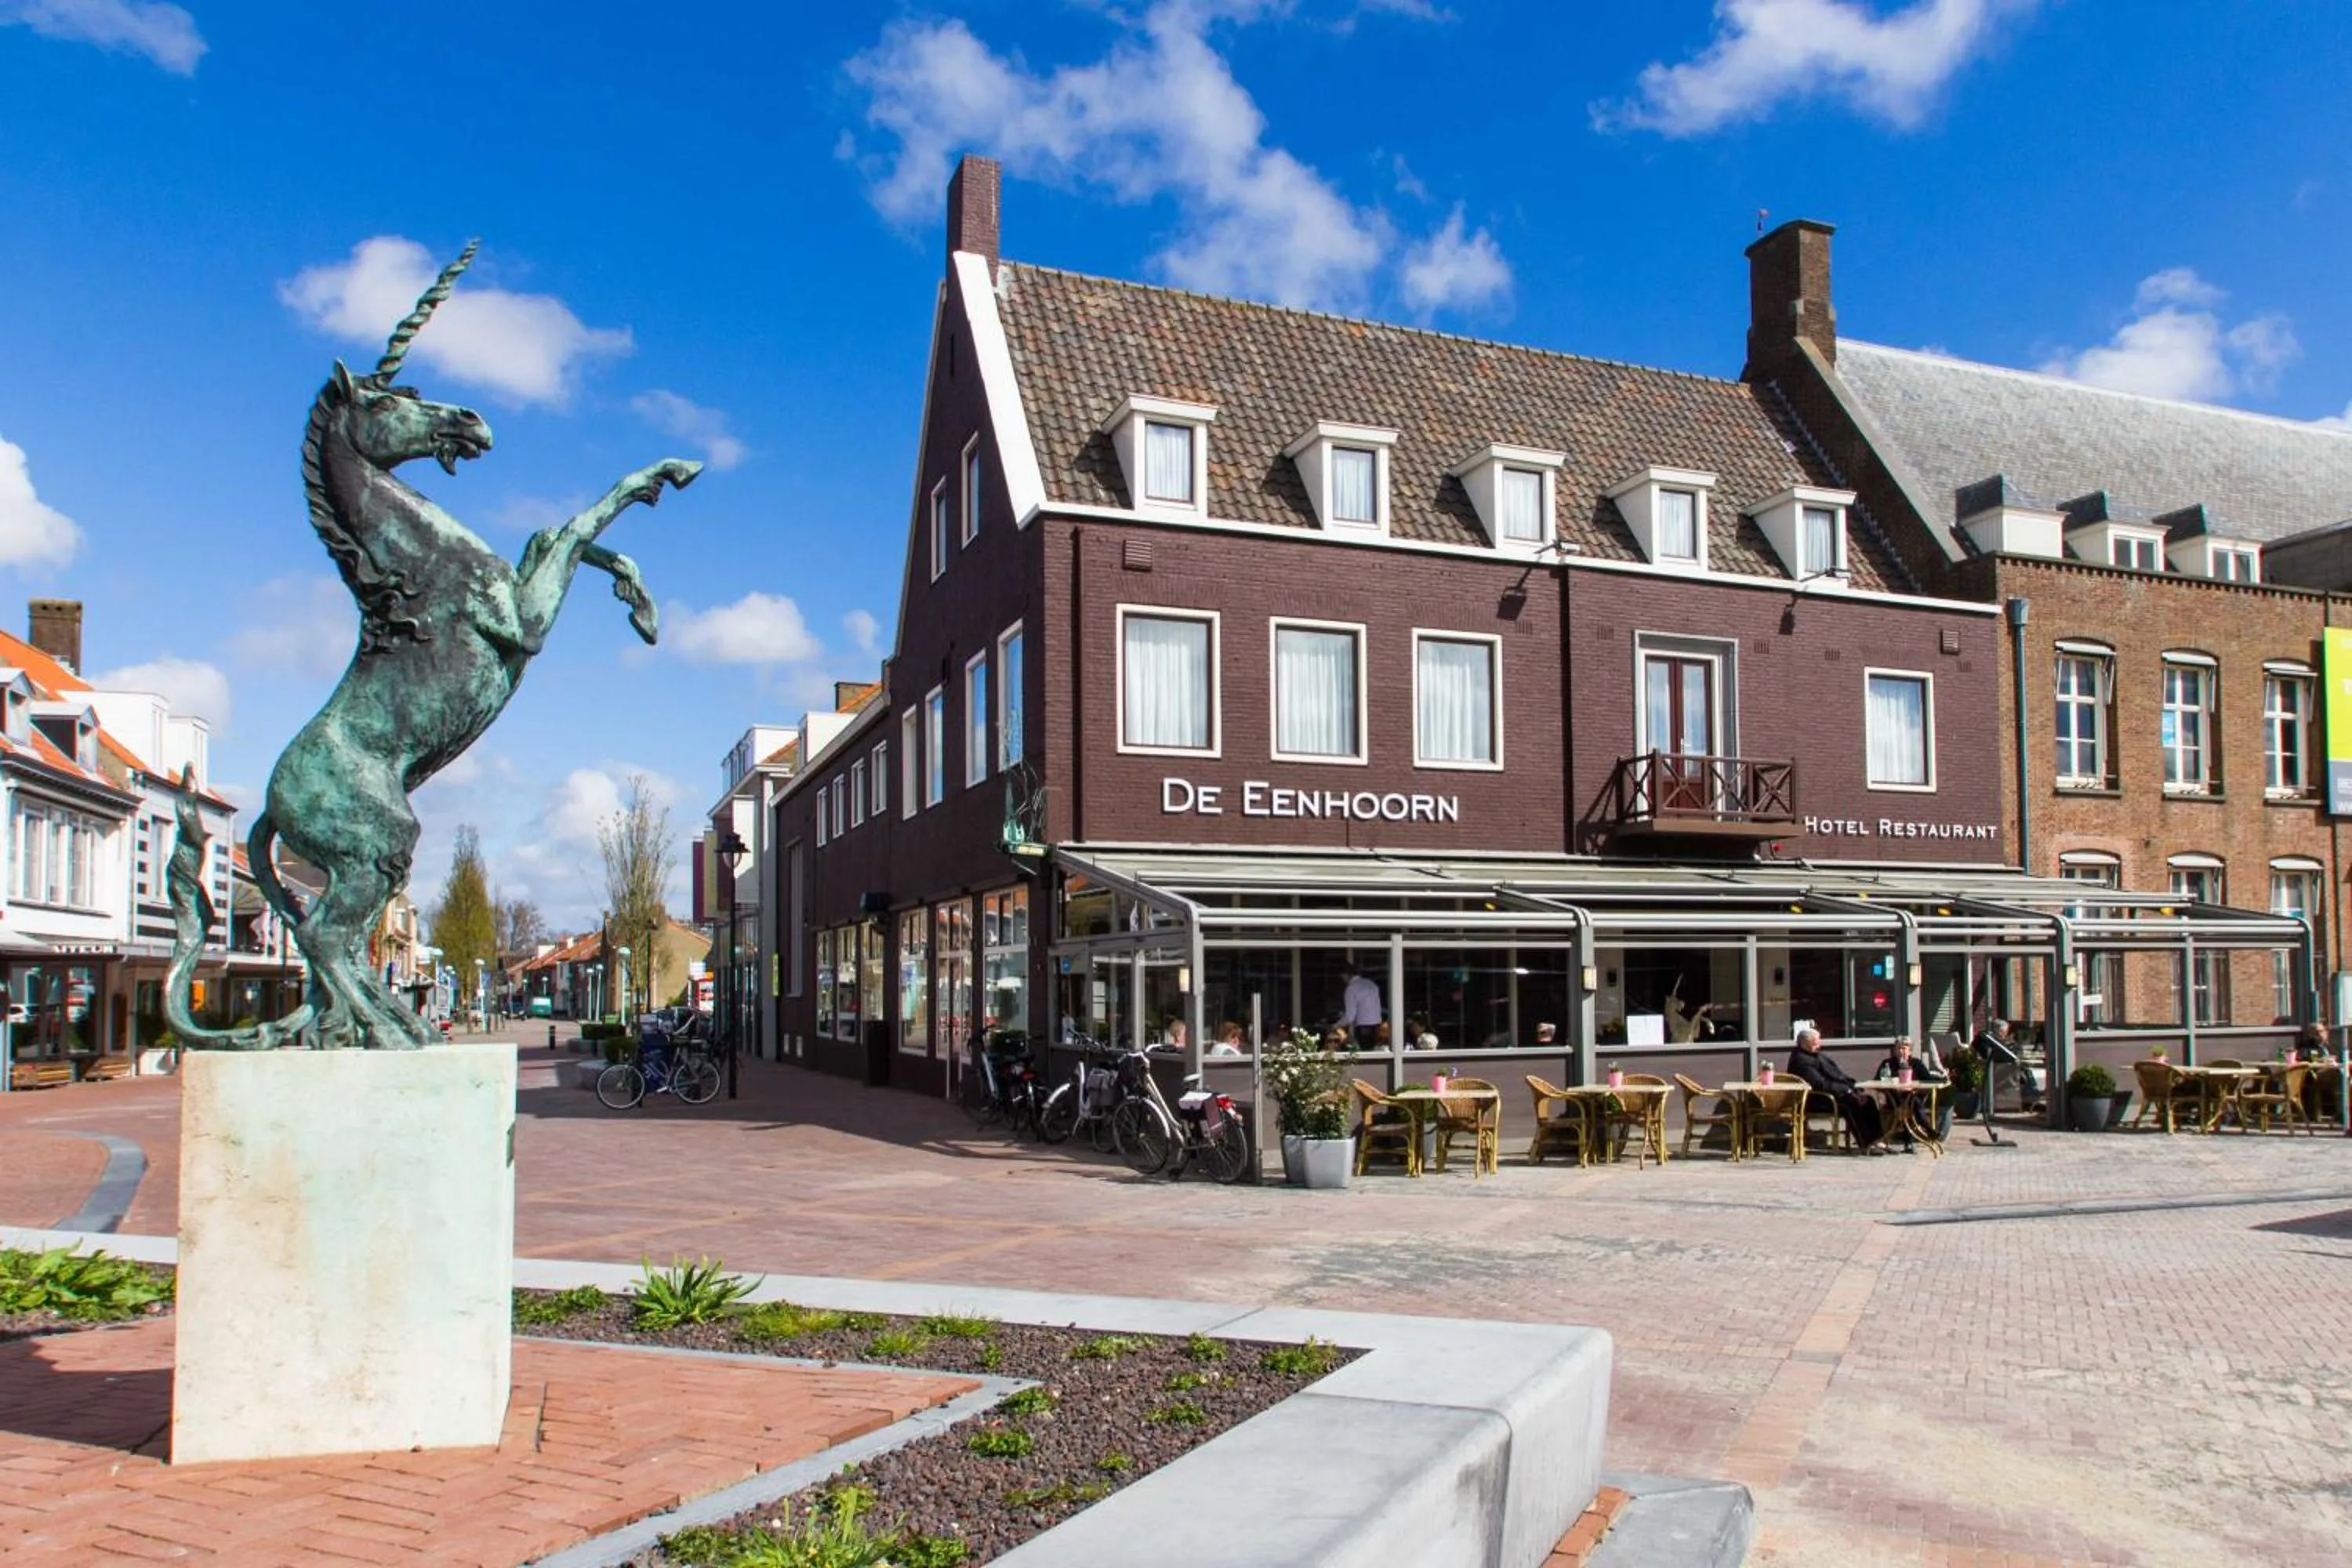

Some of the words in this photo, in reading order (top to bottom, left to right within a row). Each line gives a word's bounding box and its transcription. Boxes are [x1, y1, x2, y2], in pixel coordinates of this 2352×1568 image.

[1163, 777, 1222, 814] DE
[1243, 780, 1458, 822] EENHOORN
[1805, 815, 1870, 835] HOTEL
[1879, 818, 1998, 838] RESTAURANT
